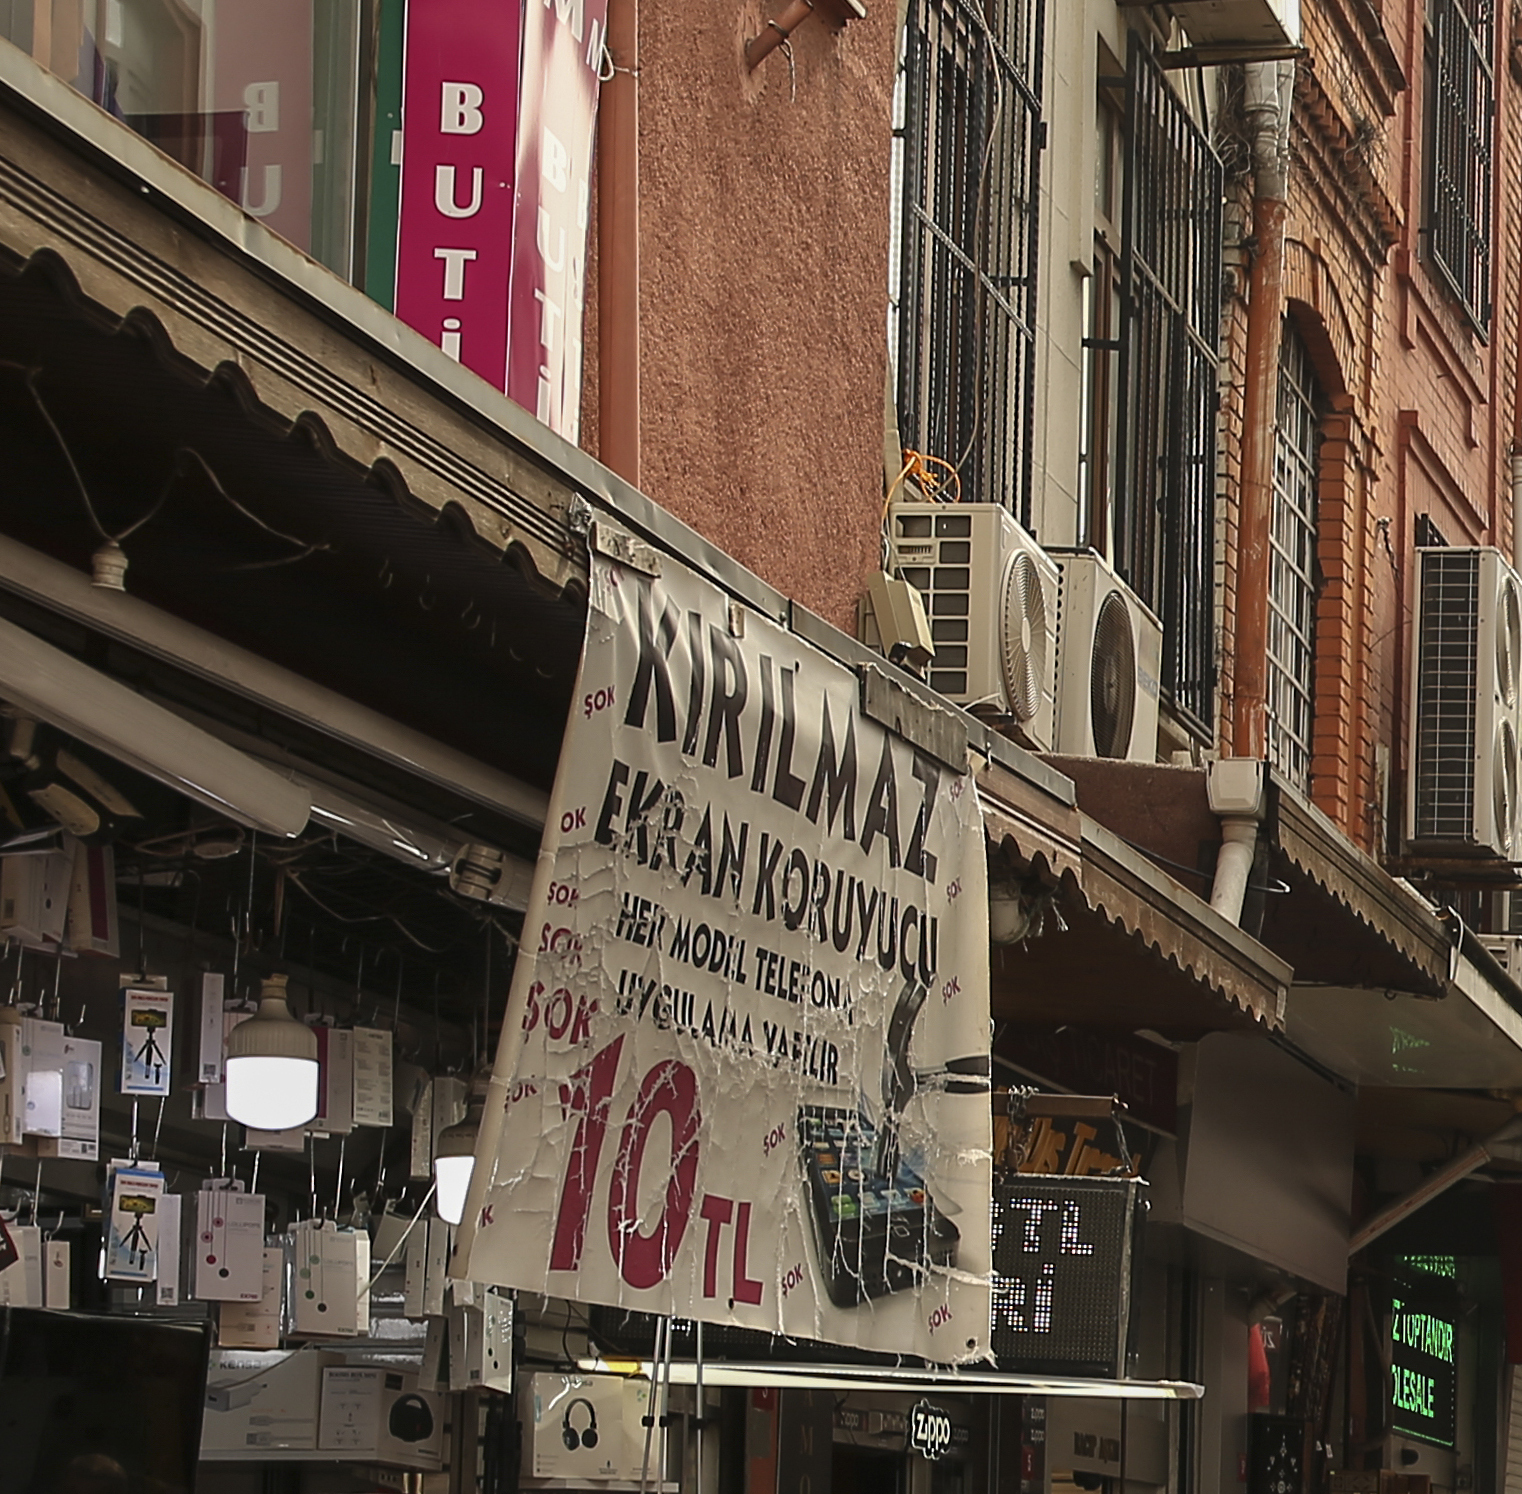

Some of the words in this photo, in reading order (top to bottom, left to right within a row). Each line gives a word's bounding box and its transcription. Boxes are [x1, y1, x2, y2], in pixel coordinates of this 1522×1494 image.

[584, 685, 616, 720] ŞOK
[624, 577, 941, 884] KIRILMAZ
[560, 806, 587, 834] OK
[594, 758, 749, 906] EKRAN
[752, 832, 939, 988] KORUYUCU
[763, 1122, 787, 1158] ŞOK
[549, 1033, 702, 1290] 10
[700, 1194, 764, 1306] TL
[781, 1262, 804, 1299] ŞOK
[927, 1303, 954, 1337] ŞOK
